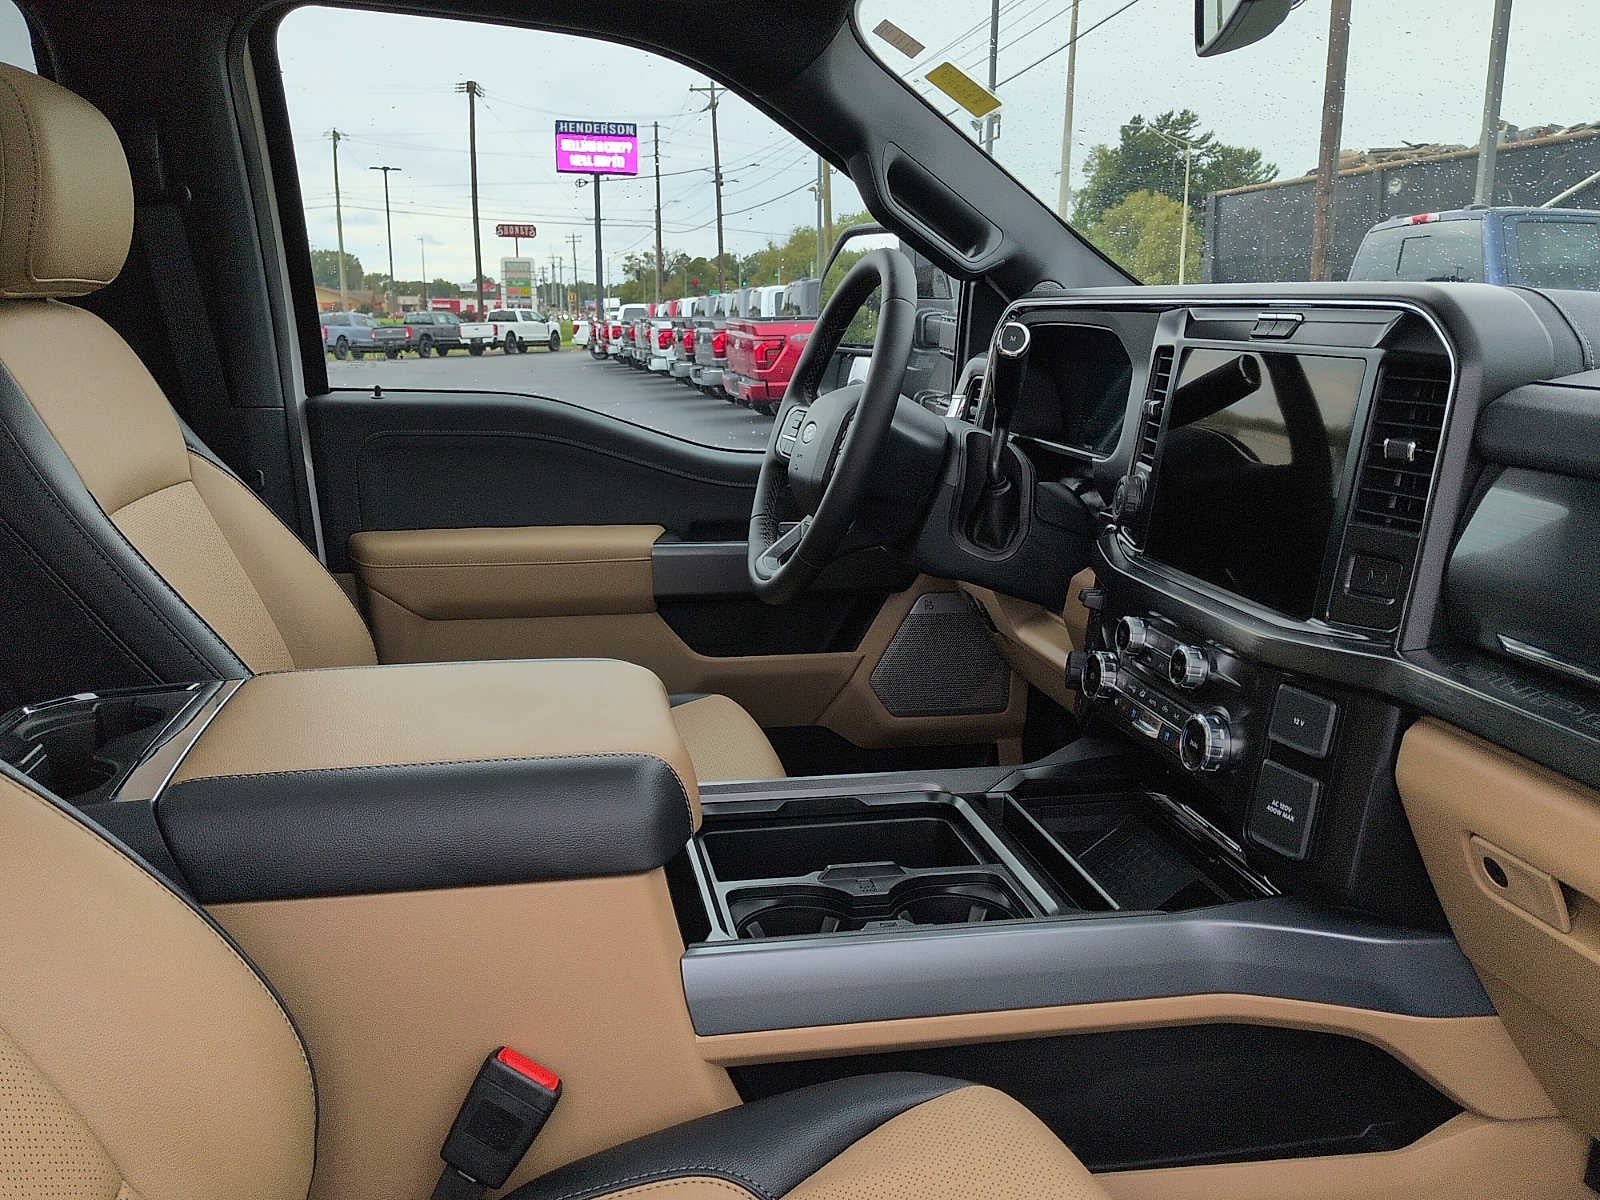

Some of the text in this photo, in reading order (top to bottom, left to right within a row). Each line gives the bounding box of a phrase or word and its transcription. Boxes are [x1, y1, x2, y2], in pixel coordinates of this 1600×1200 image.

[559, 122, 635, 136] HENDERSON
[1271, 799, 1280, 808] AC
[1282, 811, 1295, 823] MAX
